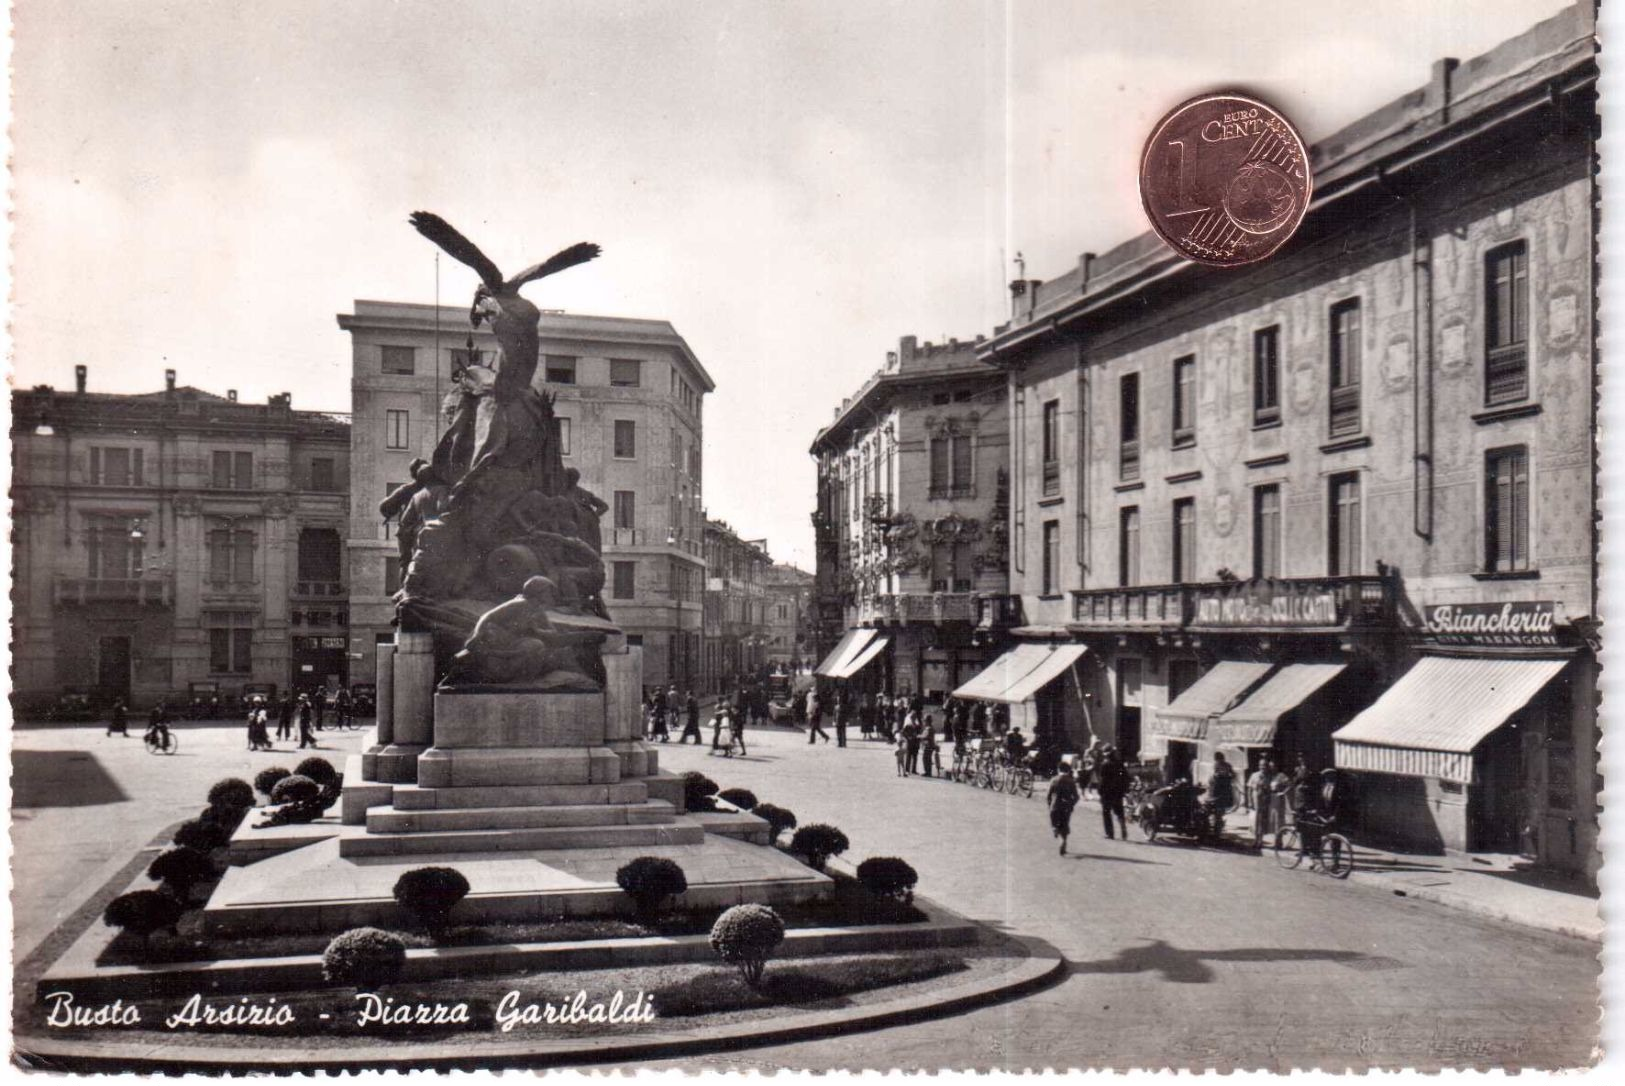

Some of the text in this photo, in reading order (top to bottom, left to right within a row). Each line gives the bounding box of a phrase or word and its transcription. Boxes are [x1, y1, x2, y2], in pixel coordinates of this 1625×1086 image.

[1224, 108, 1258, 123] EURO
[1201, 118, 1263, 143] CENT
[1166, 140, 1211, 218] 1
[1428, 602, 1553, 633] Biancheria
